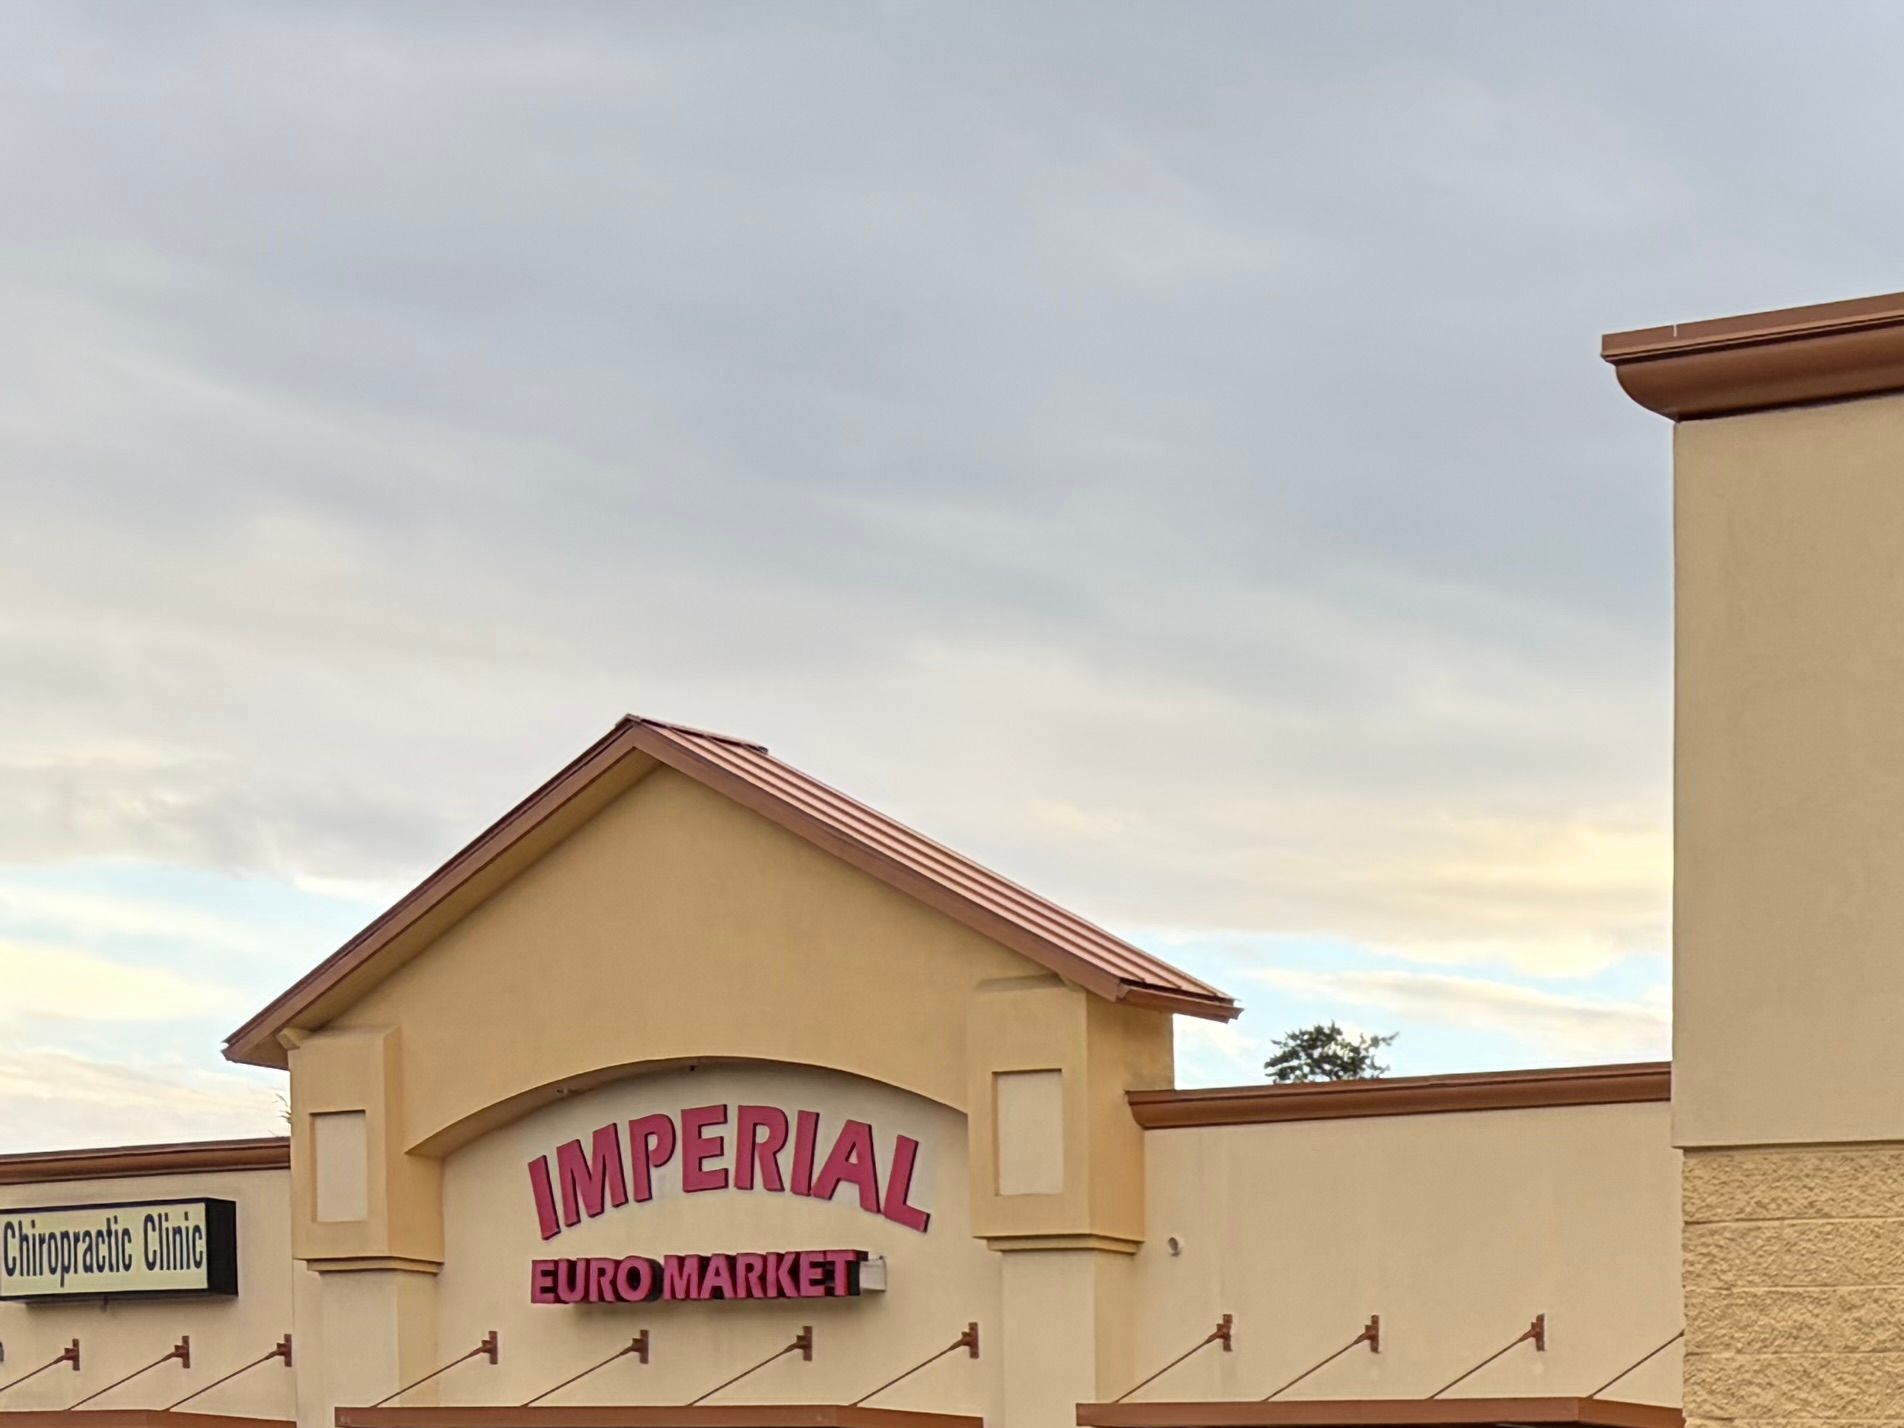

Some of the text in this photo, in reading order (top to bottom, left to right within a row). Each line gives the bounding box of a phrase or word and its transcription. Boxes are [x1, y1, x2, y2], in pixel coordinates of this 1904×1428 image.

[528, 1103, 931, 1241] IMPERIAL
[3, 1211, 204, 1288] Chiropractic Clinic
[531, 1249, 862, 1304] EURO MARKET
